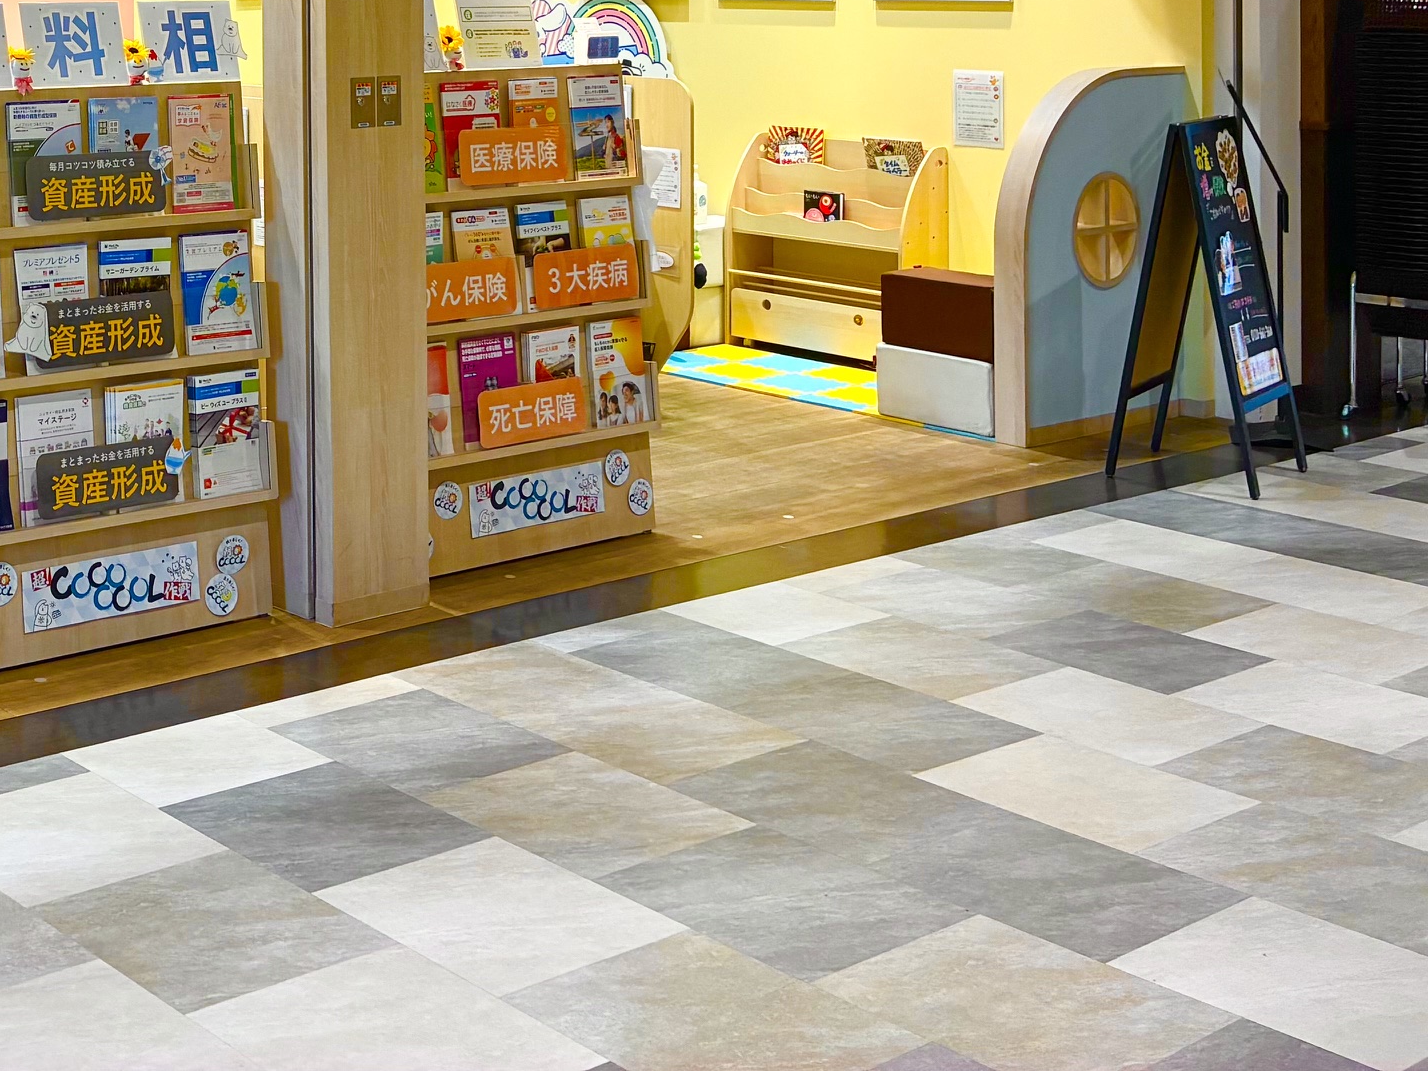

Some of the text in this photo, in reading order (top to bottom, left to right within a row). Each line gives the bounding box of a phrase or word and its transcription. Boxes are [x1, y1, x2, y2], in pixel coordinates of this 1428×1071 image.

[48, 157, 136, 172] 毎月コツコツ積み立てる
[469, 138, 559, 173] 医療保険
[40, 171, 155, 213] 資産形成
[427, 272, 508, 310] がん保険
[57, 299, 152, 319] まとまったお金を活用する
[48, 313, 165, 361] 資産形成
[37, 413, 77, 426] マイステージ
[489, 391, 578, 435] 死亡保障
[59, 445, 156, 468] まとまったお金を活用する
[51, 460, 168, 511] 資産形成
[163, 581, 192, 601] 作戦
